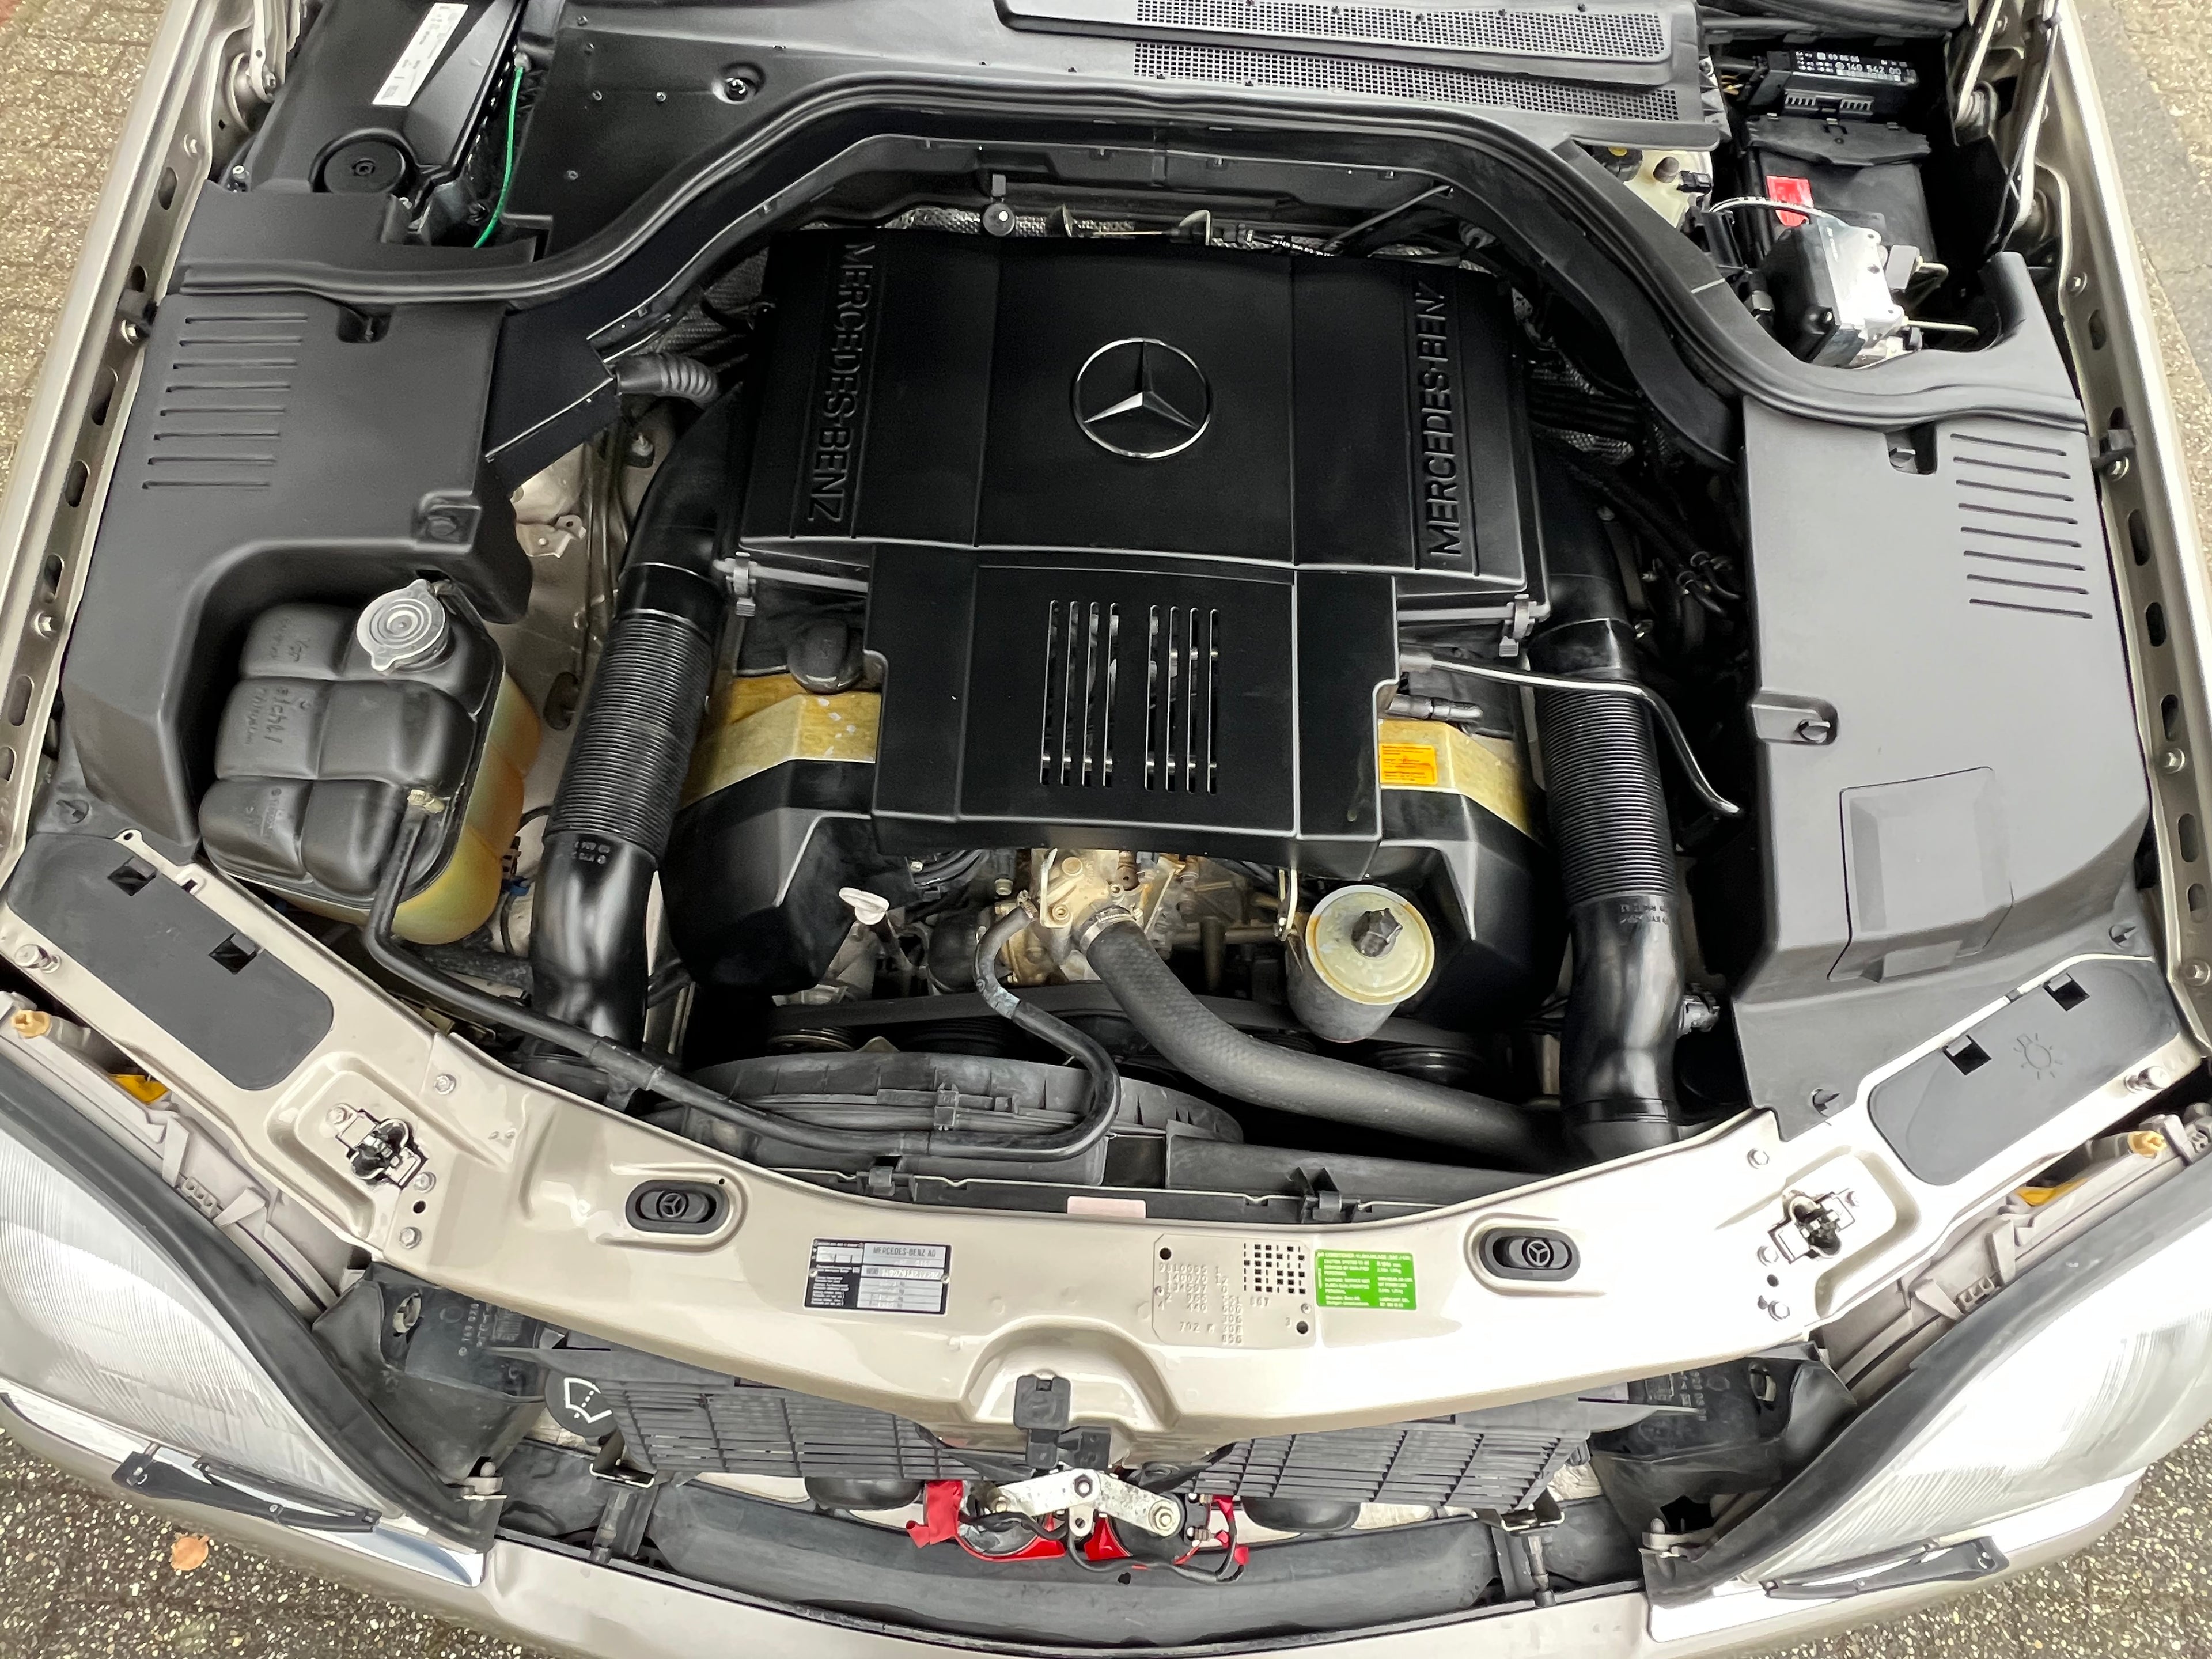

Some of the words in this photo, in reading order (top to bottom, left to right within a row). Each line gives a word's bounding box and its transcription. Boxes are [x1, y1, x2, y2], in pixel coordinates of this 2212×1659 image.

[808, 243, 876, 522] MERCEDES-BENZ
[1415, 280, 1462, 558] MERCEDES-BENZ
[873, 1246, 926, 1256] MERCEDES-BENZ
